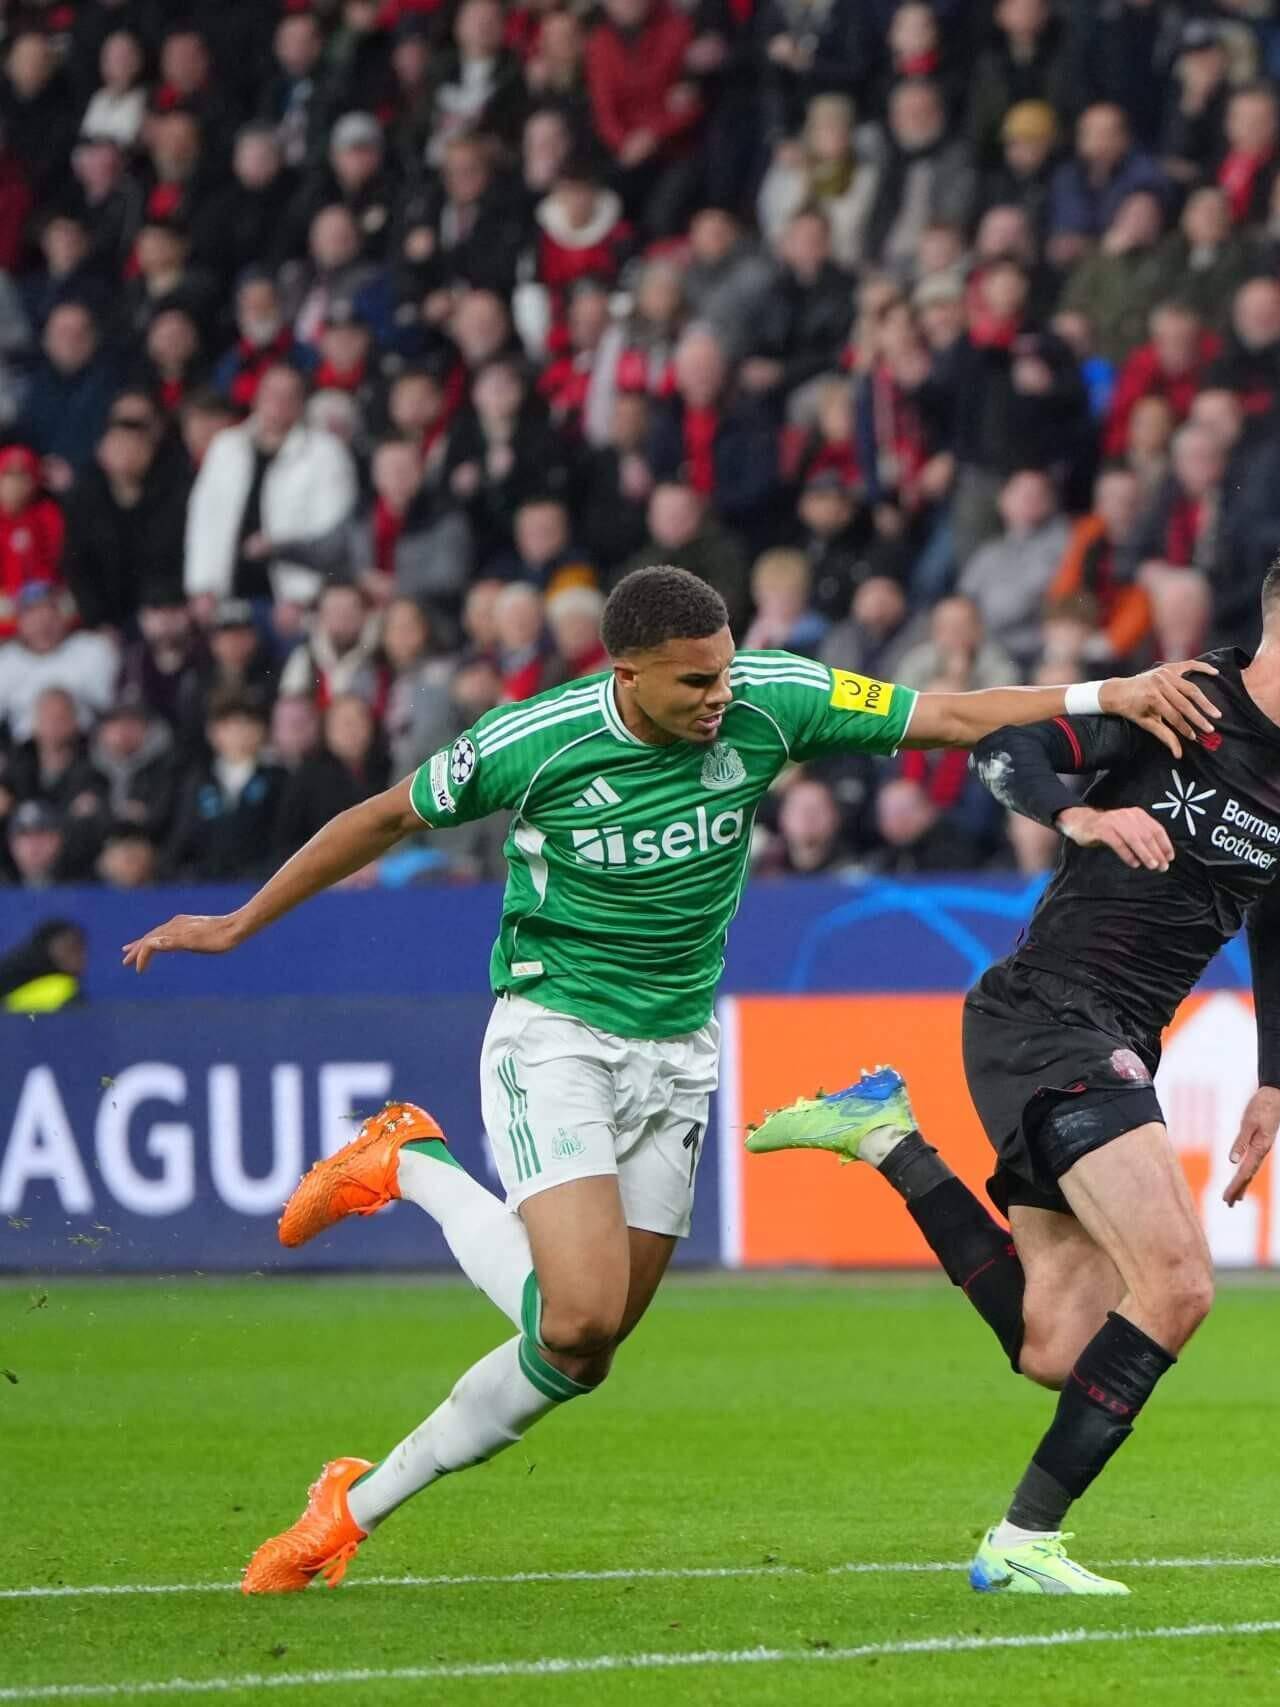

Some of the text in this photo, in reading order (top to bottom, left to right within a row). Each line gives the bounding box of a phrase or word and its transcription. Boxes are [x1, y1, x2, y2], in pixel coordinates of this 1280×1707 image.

[865, 681, 882, 709] noo
[632, 806, 744, 865] sela
[1211, 825, 1278, 870] Gothaer
